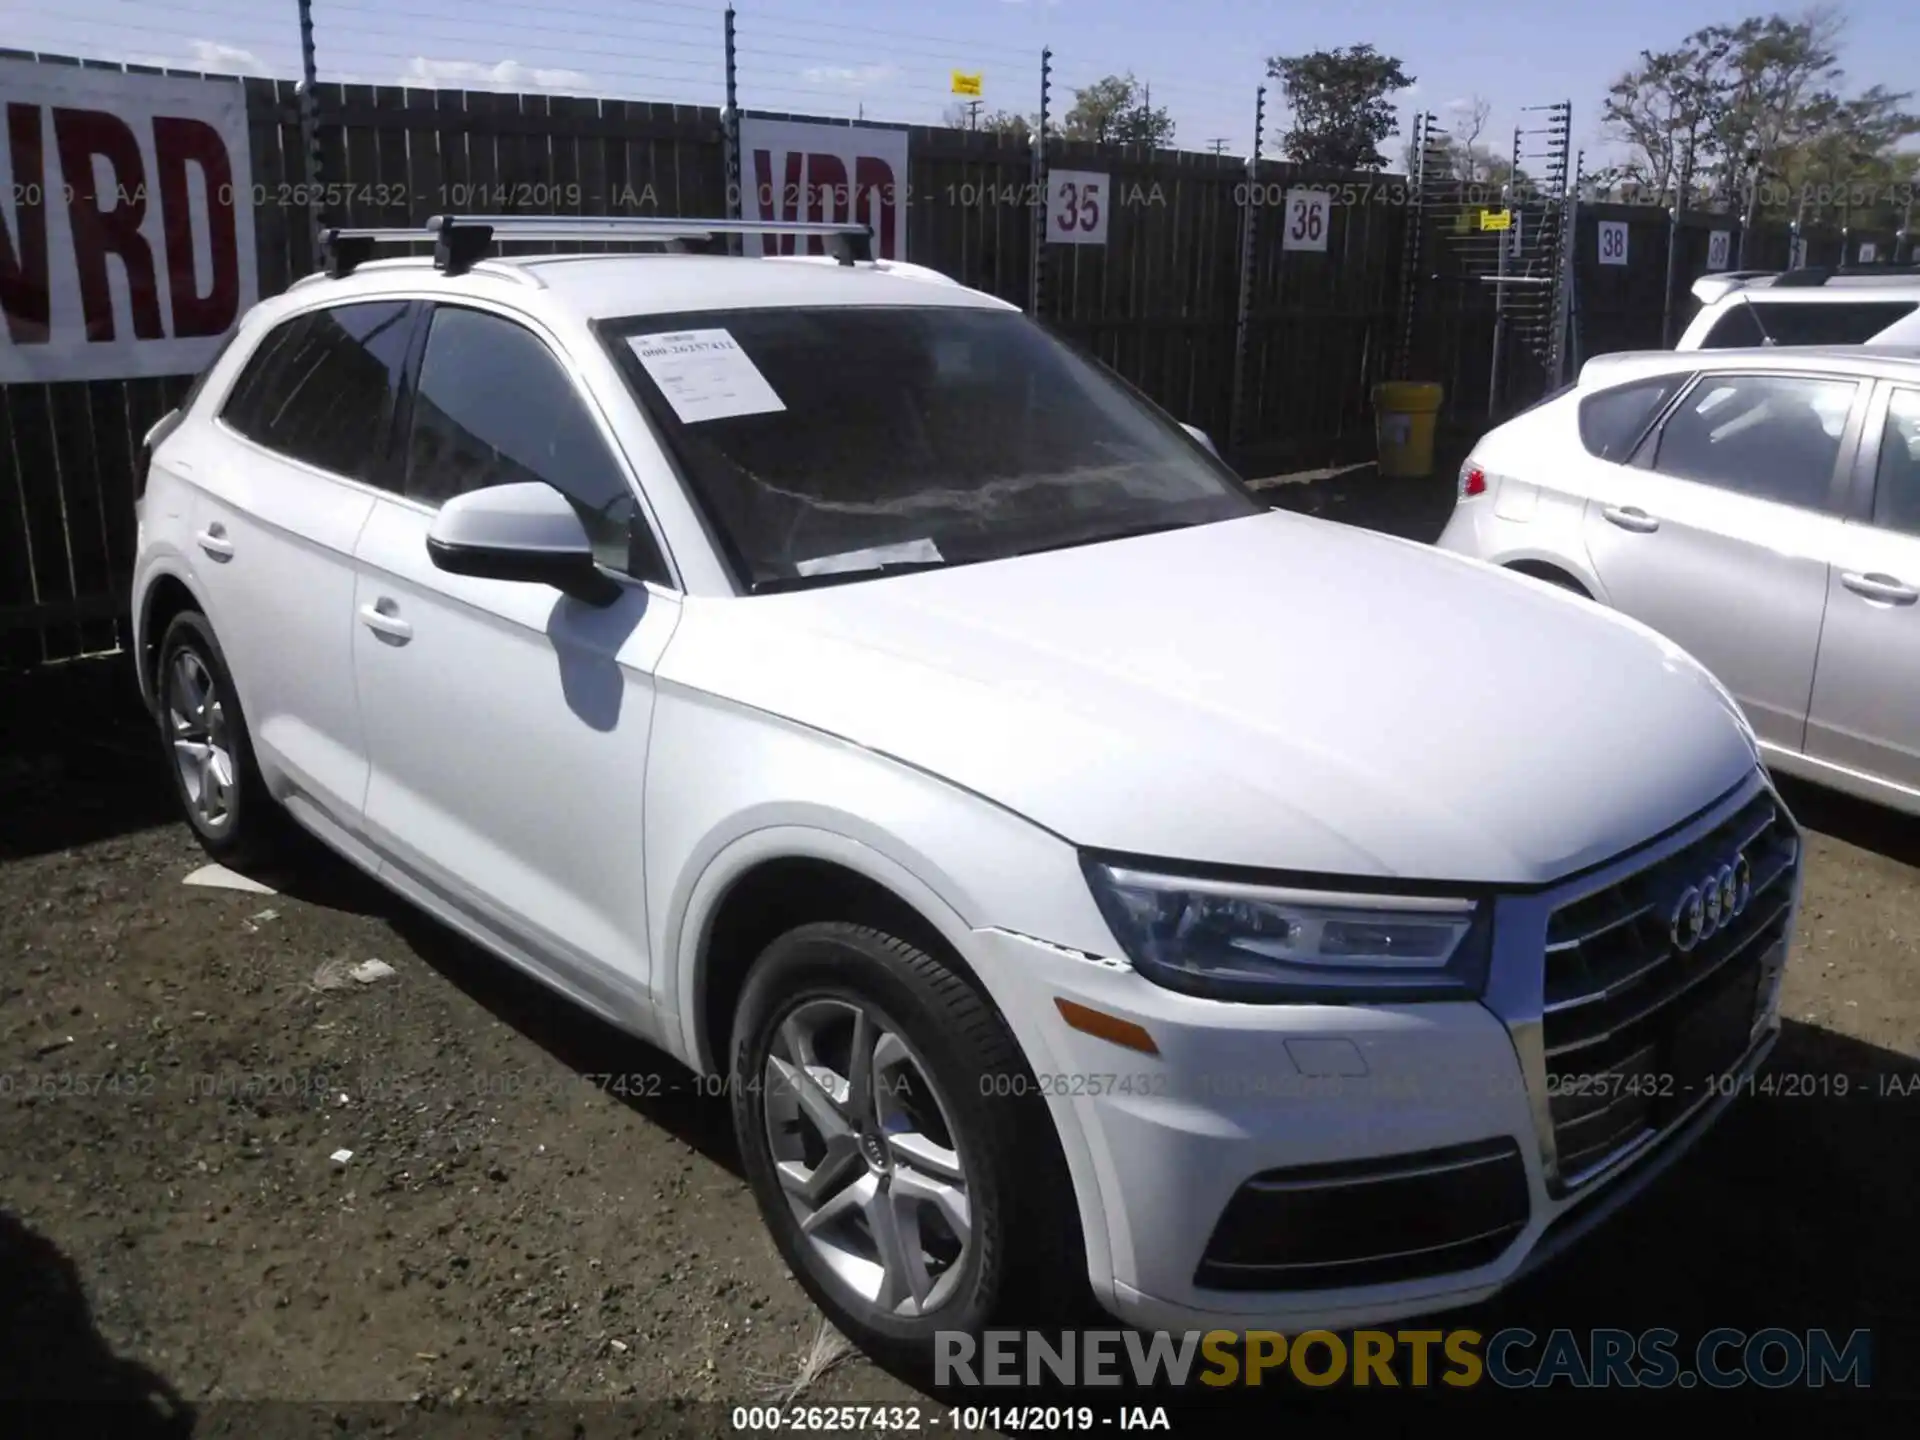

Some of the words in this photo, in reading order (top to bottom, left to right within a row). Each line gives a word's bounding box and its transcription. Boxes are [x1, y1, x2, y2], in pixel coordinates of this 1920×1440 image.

[1057, 182, 1099, 232] 35
[1292, 200, 1322, 241] 36
[1603, 229, 1624, 258] 38
